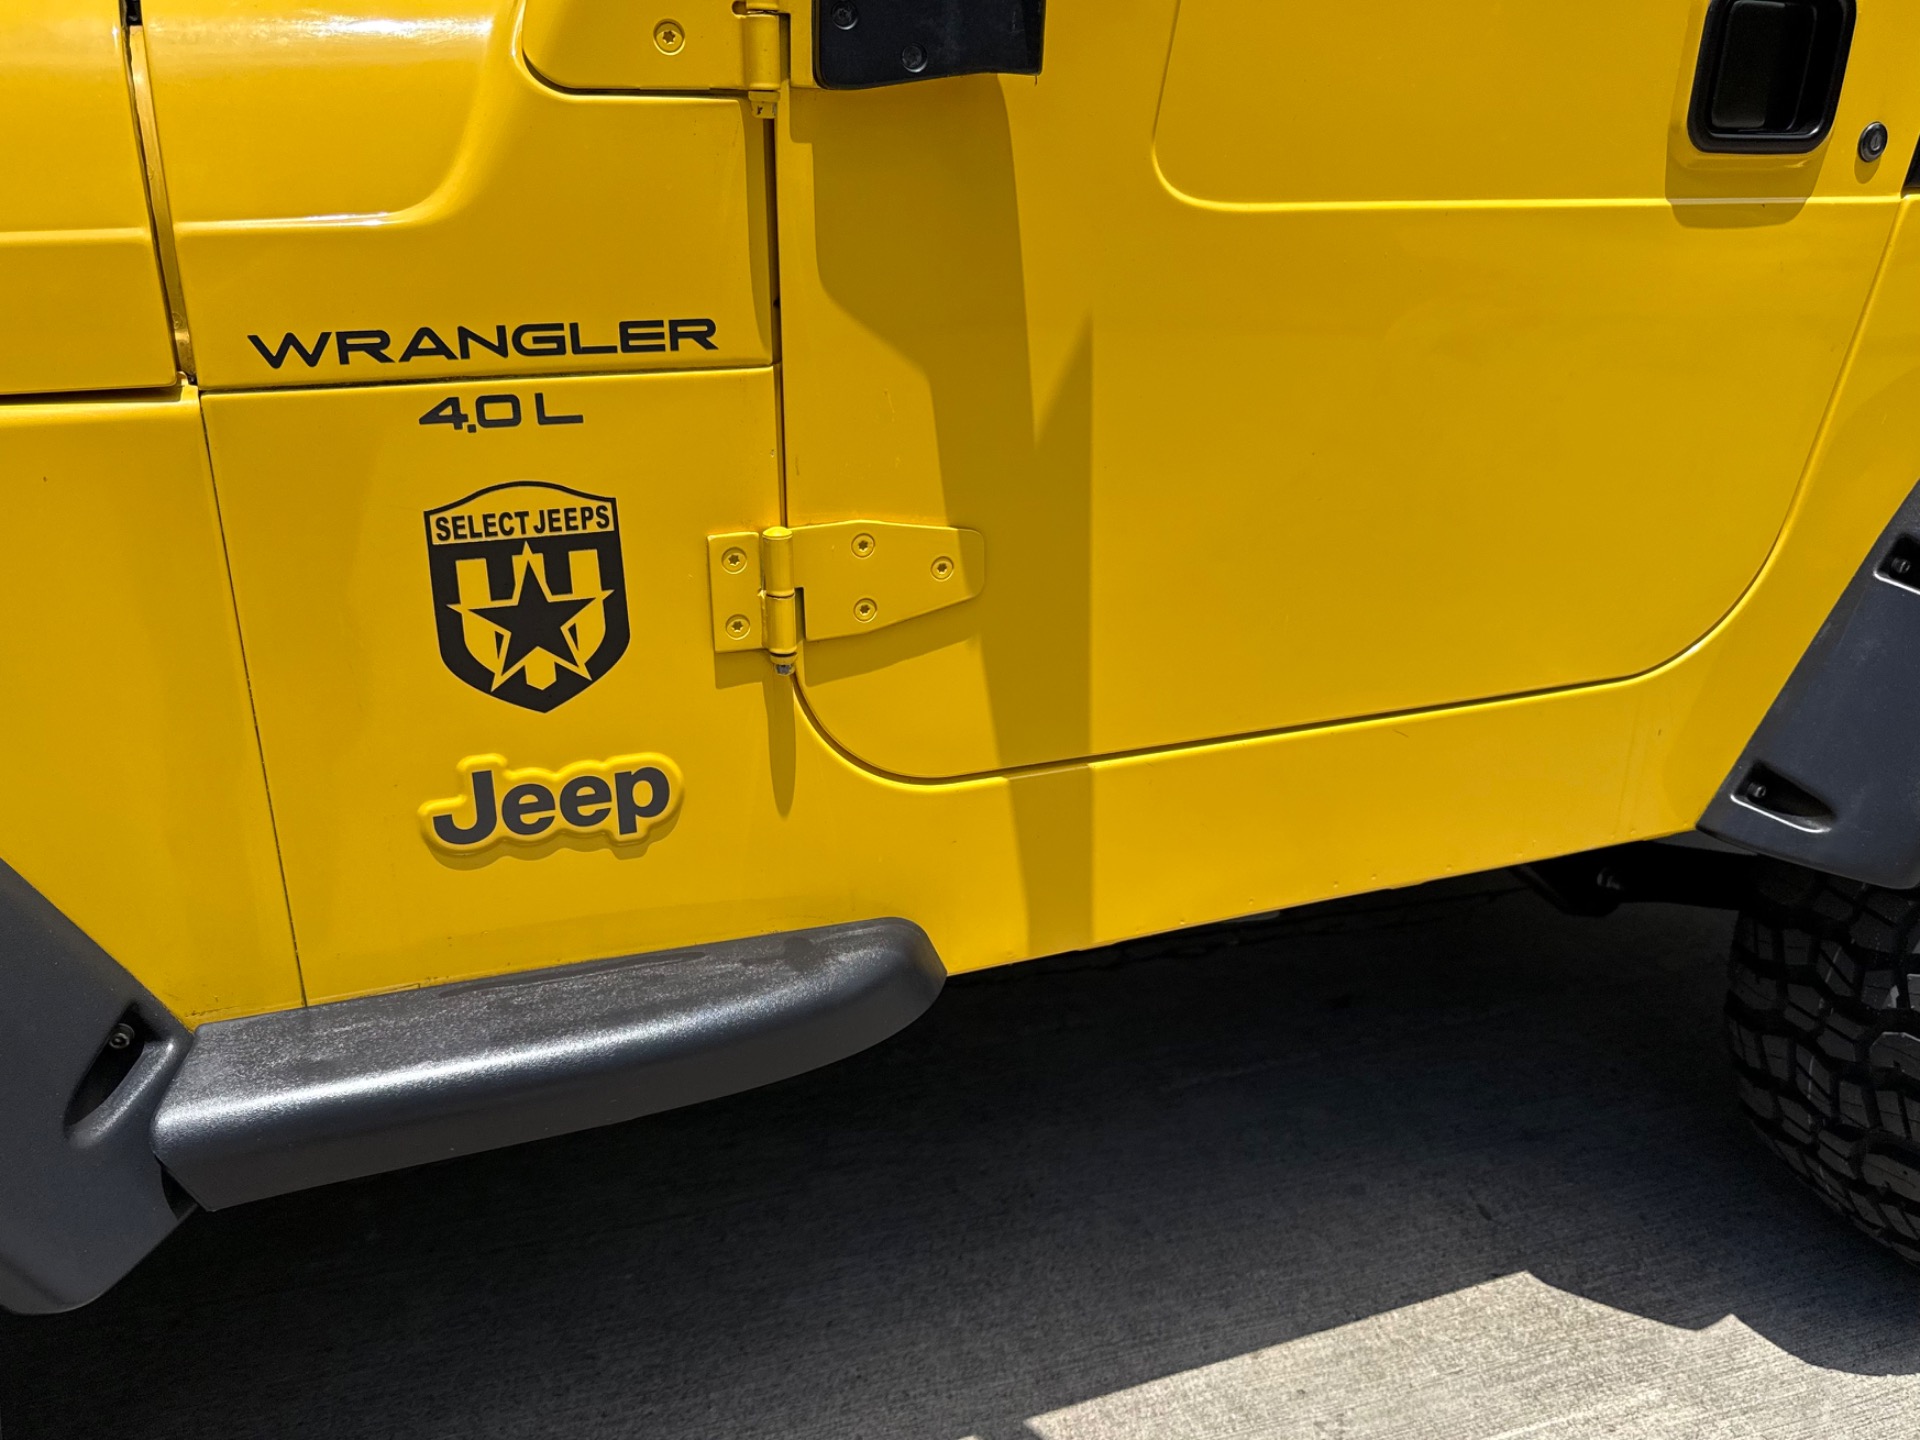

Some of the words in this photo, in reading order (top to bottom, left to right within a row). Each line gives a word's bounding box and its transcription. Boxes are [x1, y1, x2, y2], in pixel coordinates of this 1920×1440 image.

[247, 319, 718, 370] WRANGLER
[435, 510, 530, 541] SELECT
[533, 504, 610, 534] JEEPS
[432, 767, 670, 846] Jeep
